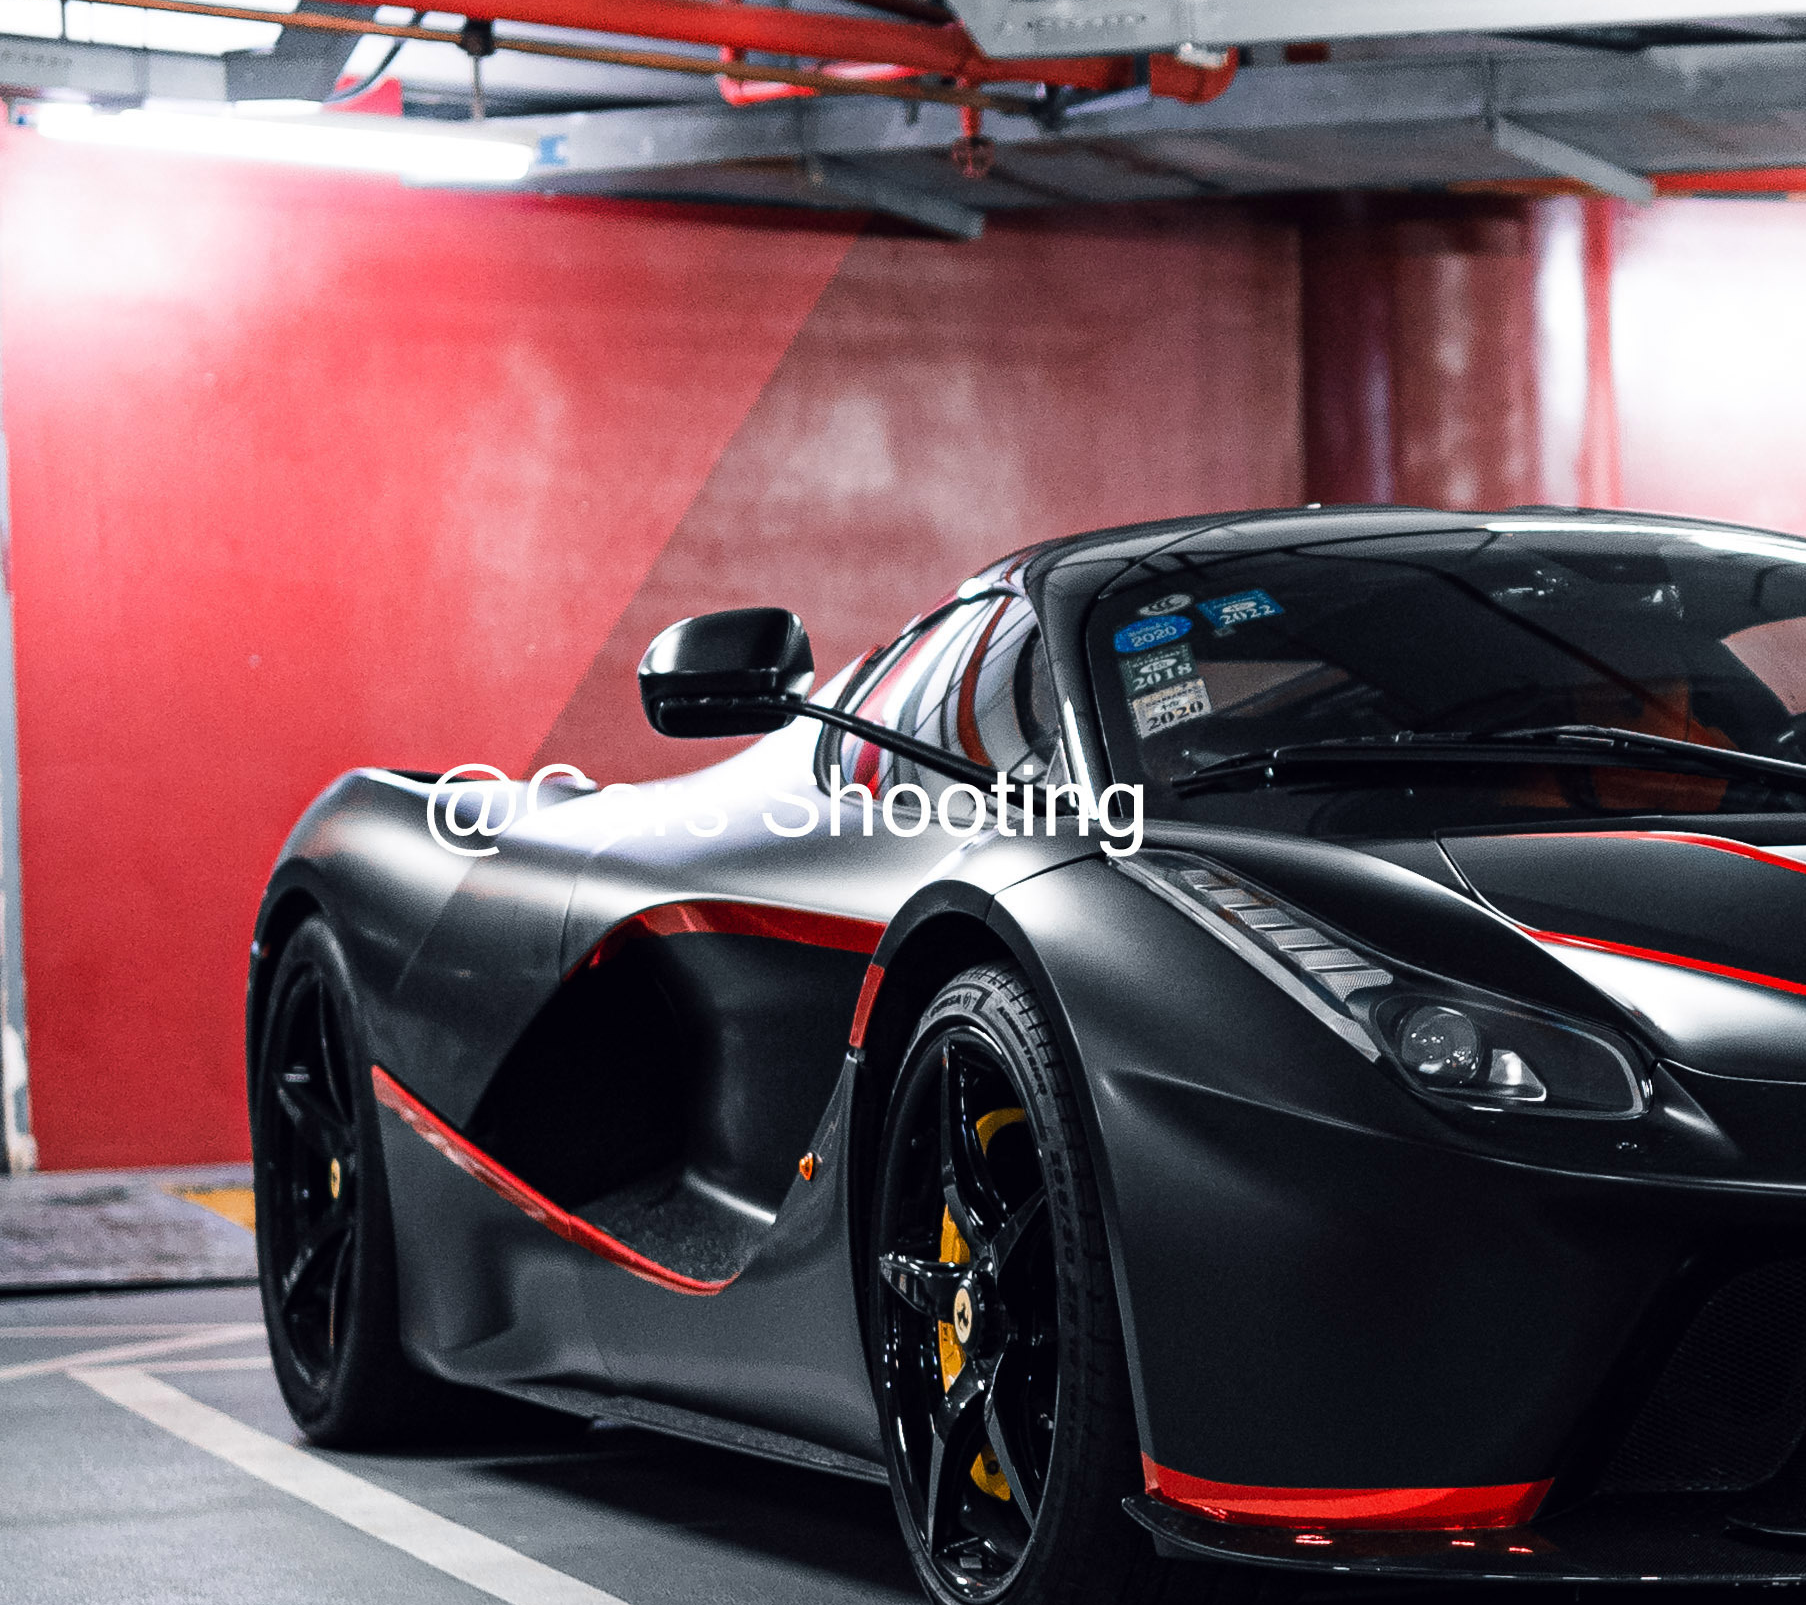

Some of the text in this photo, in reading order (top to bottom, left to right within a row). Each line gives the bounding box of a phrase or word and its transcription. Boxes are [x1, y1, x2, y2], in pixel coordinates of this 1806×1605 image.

[1219, 605, 1276, 625] 2022
[1131, 626, 1177, 648] 2020
[1133, 662, 1193, 692] 2018
[1147, 700, 1204, 731] 2020
